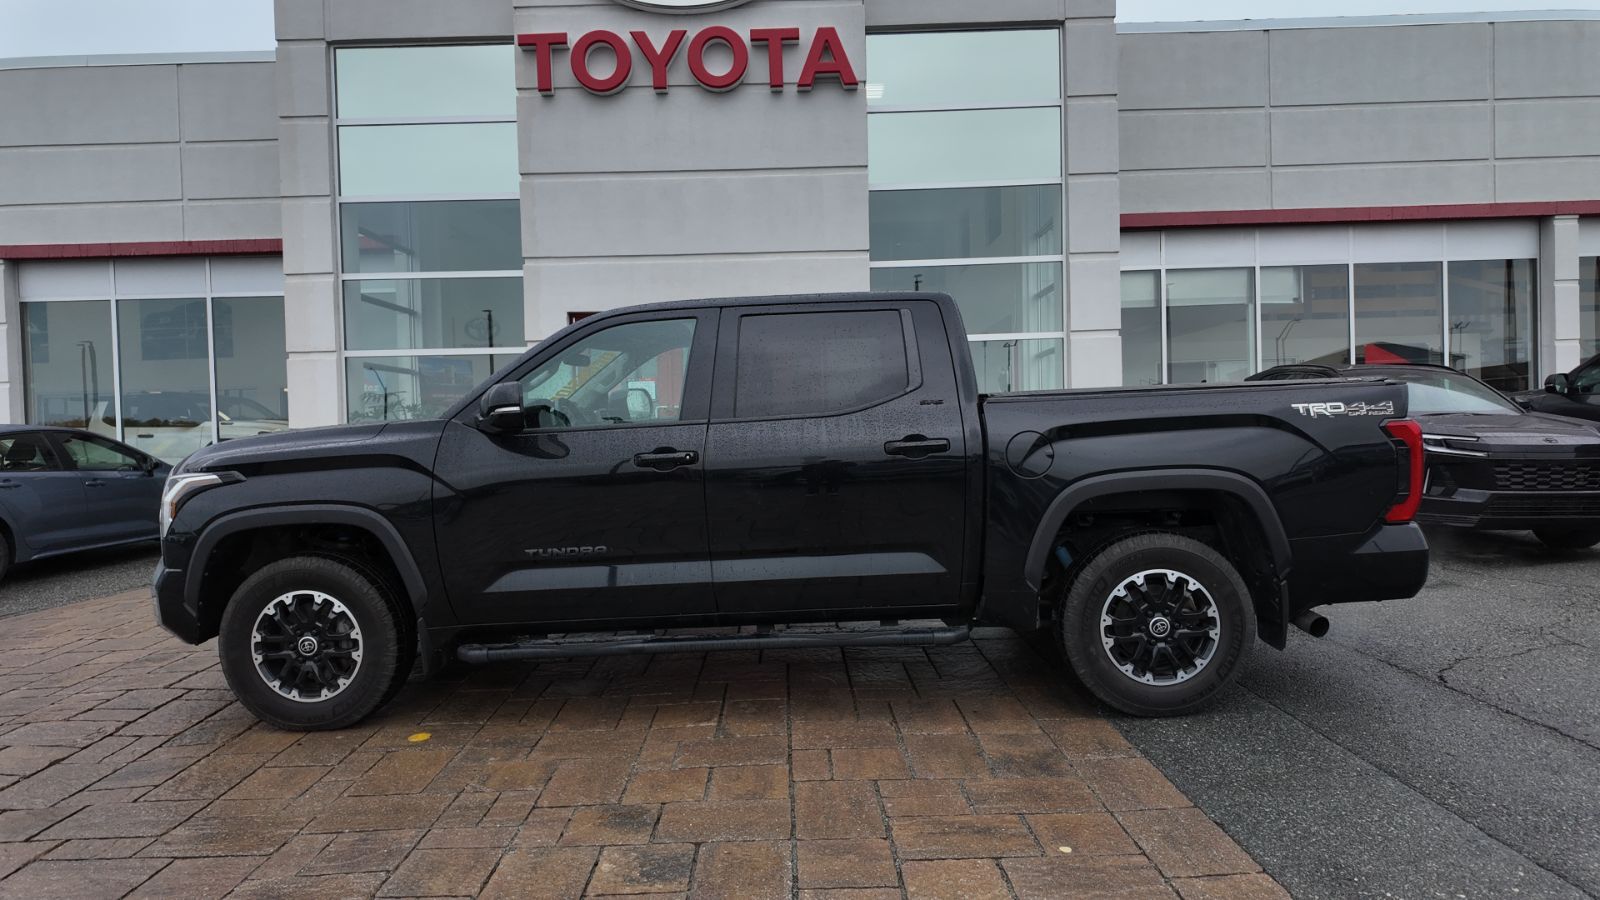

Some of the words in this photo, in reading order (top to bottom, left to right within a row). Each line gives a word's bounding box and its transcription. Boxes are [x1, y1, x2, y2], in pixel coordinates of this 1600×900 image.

[517, 25, 858, 97] TOYOTA
[1291, 402, 1347, 418] TRD
[524, 545, 608, 557] TUNDRA
